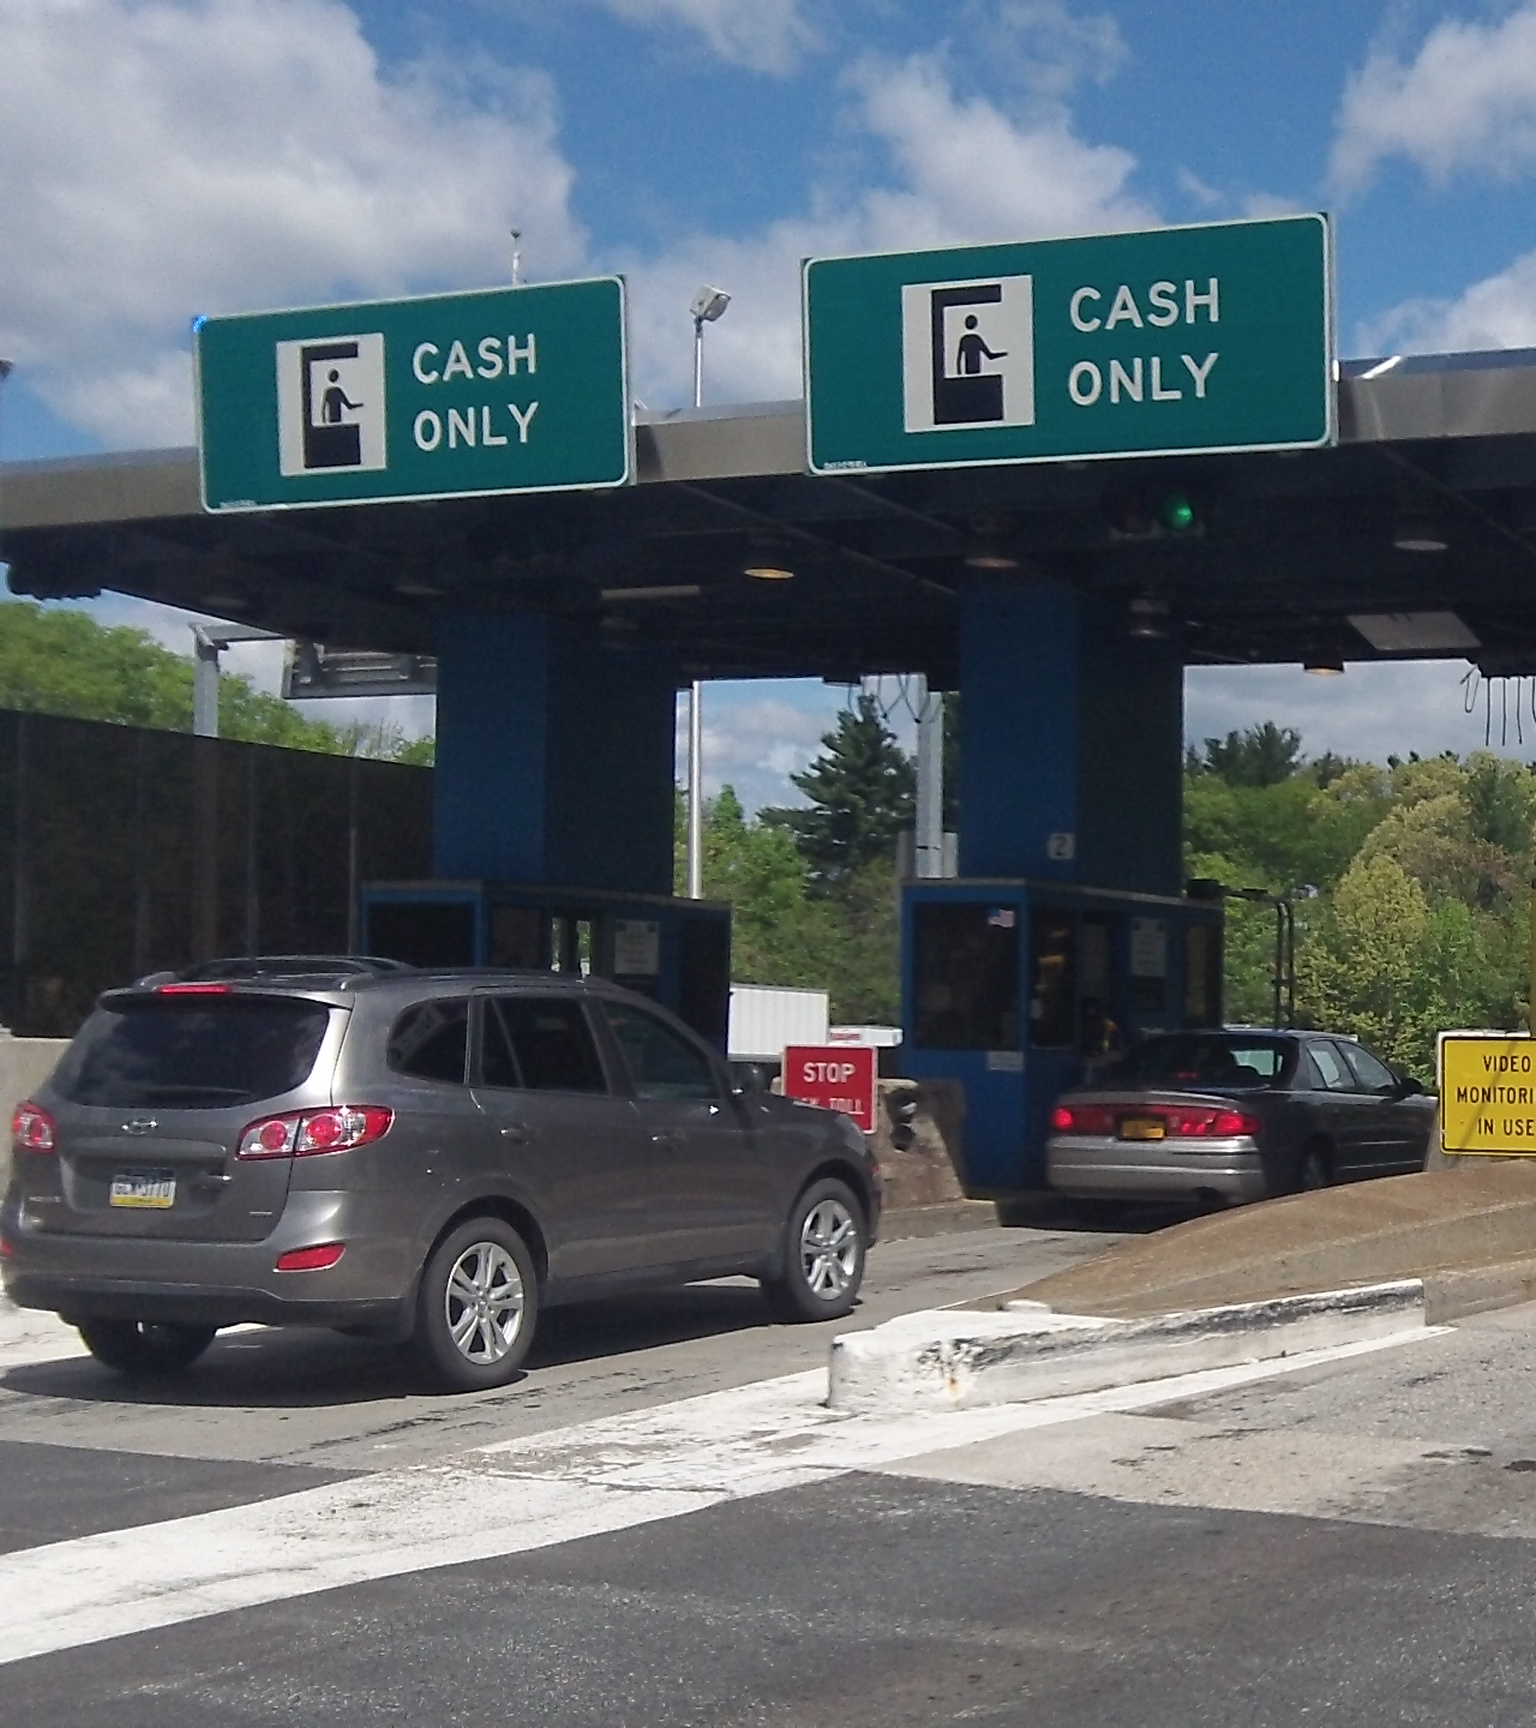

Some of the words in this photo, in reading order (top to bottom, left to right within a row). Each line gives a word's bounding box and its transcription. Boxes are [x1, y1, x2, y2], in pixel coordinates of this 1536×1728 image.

[1069, 277, 1220, 333] CASH
[412, 332, 537, 385] CASH
[1068, 352, 1219, 407] ONLY
[413, 401, 539, 453] ONLY
[803, 1061, 856, 1083] STOP
[1482, 1055, 1532, 1073] VIDEO
[1477, 1117, 1494, 1136] IN
[1503, 1118, 1536, 1137] USE
